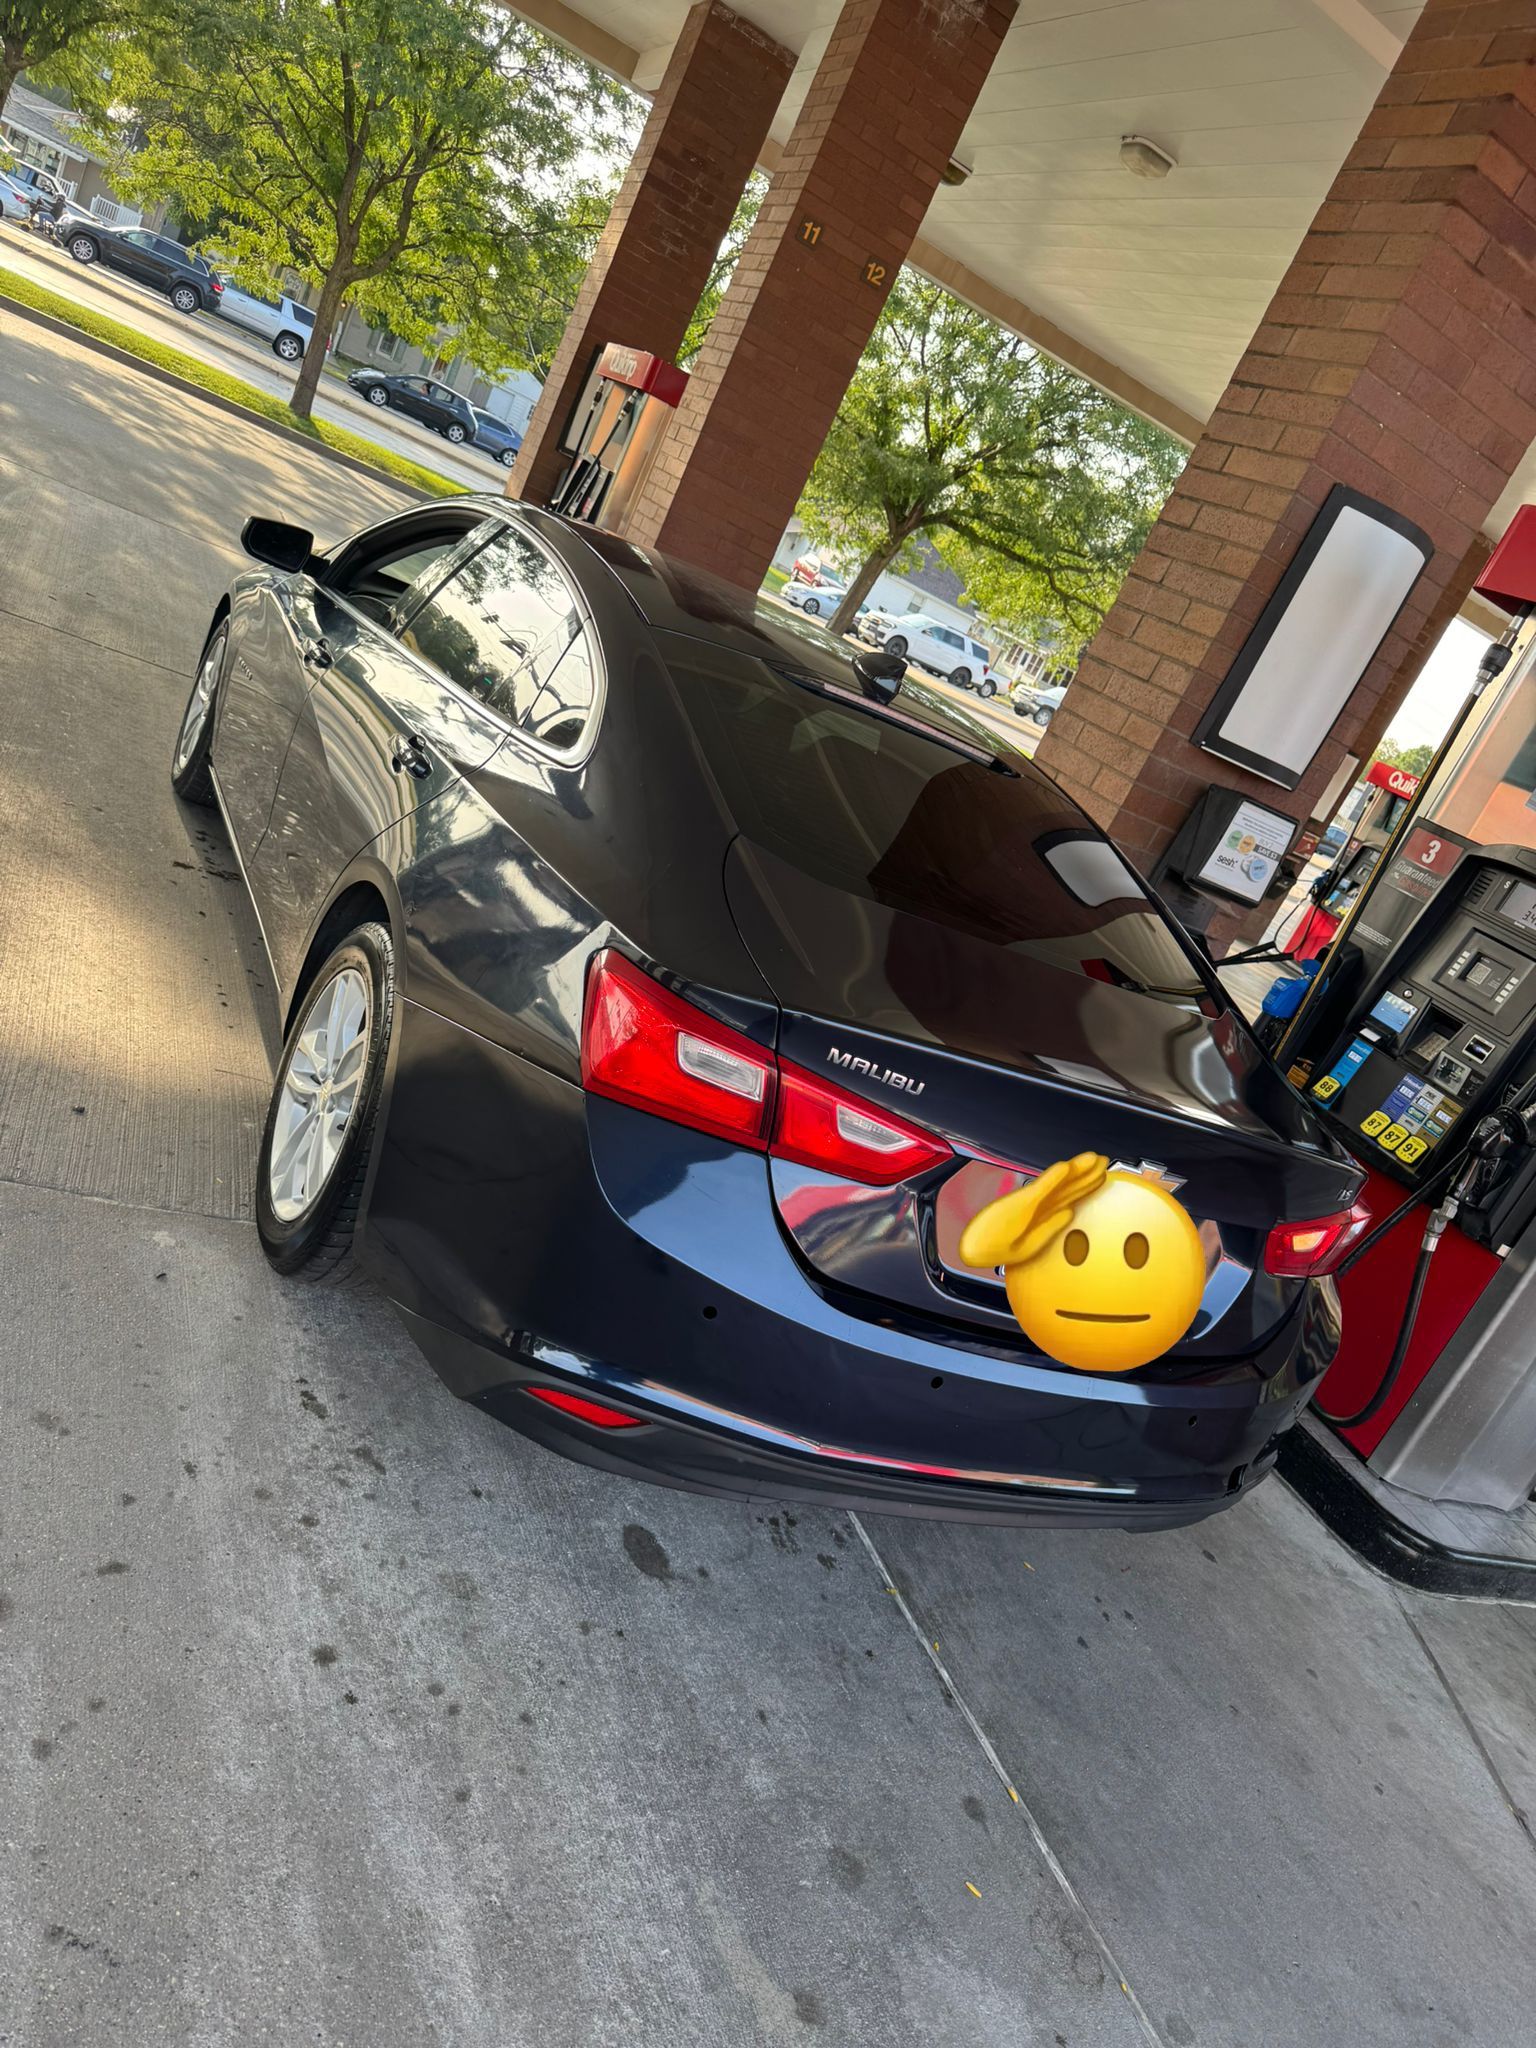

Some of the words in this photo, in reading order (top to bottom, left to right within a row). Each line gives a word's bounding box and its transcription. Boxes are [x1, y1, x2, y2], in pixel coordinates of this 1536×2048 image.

[804, 221, 822, 245] 11
[866, 261, 886, 287] 12
[1421, 839, 1442, 864] 3
[826, 1047, 925, 1096] MALIBU
[1319, 1081, 1334, 1093] 88
[1367, 1118, 1382, 1130] 87
[1384, 1130, 1401, 1144] 87
[1402, 1143, 1419, 1158] 91
